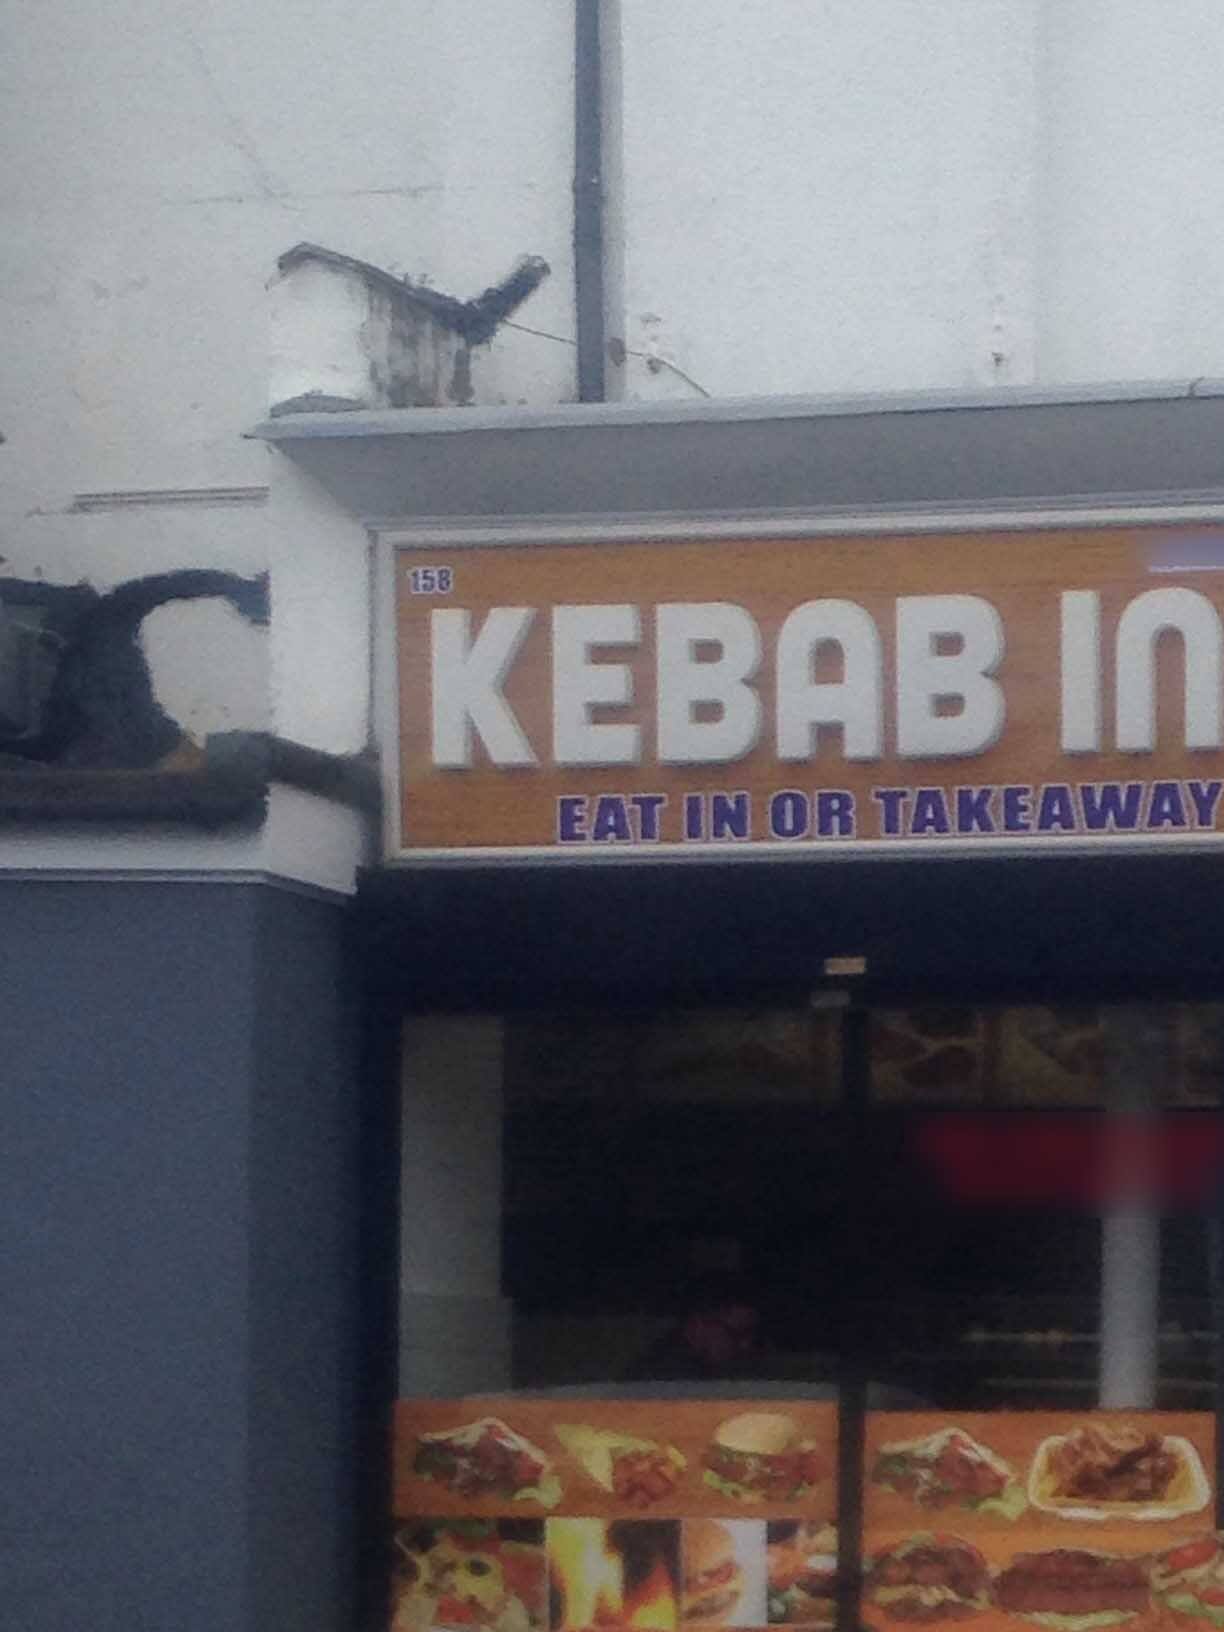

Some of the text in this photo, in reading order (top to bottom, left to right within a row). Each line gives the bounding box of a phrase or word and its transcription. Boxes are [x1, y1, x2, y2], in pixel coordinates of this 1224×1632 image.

[407, 566, 454, 595] 158
[430, 594, 1004, 770] KEBAB
[556, 794, 668, 844] EAT
[682, 790, 752, 842] IN
[769, 788, 858, 841] OR
